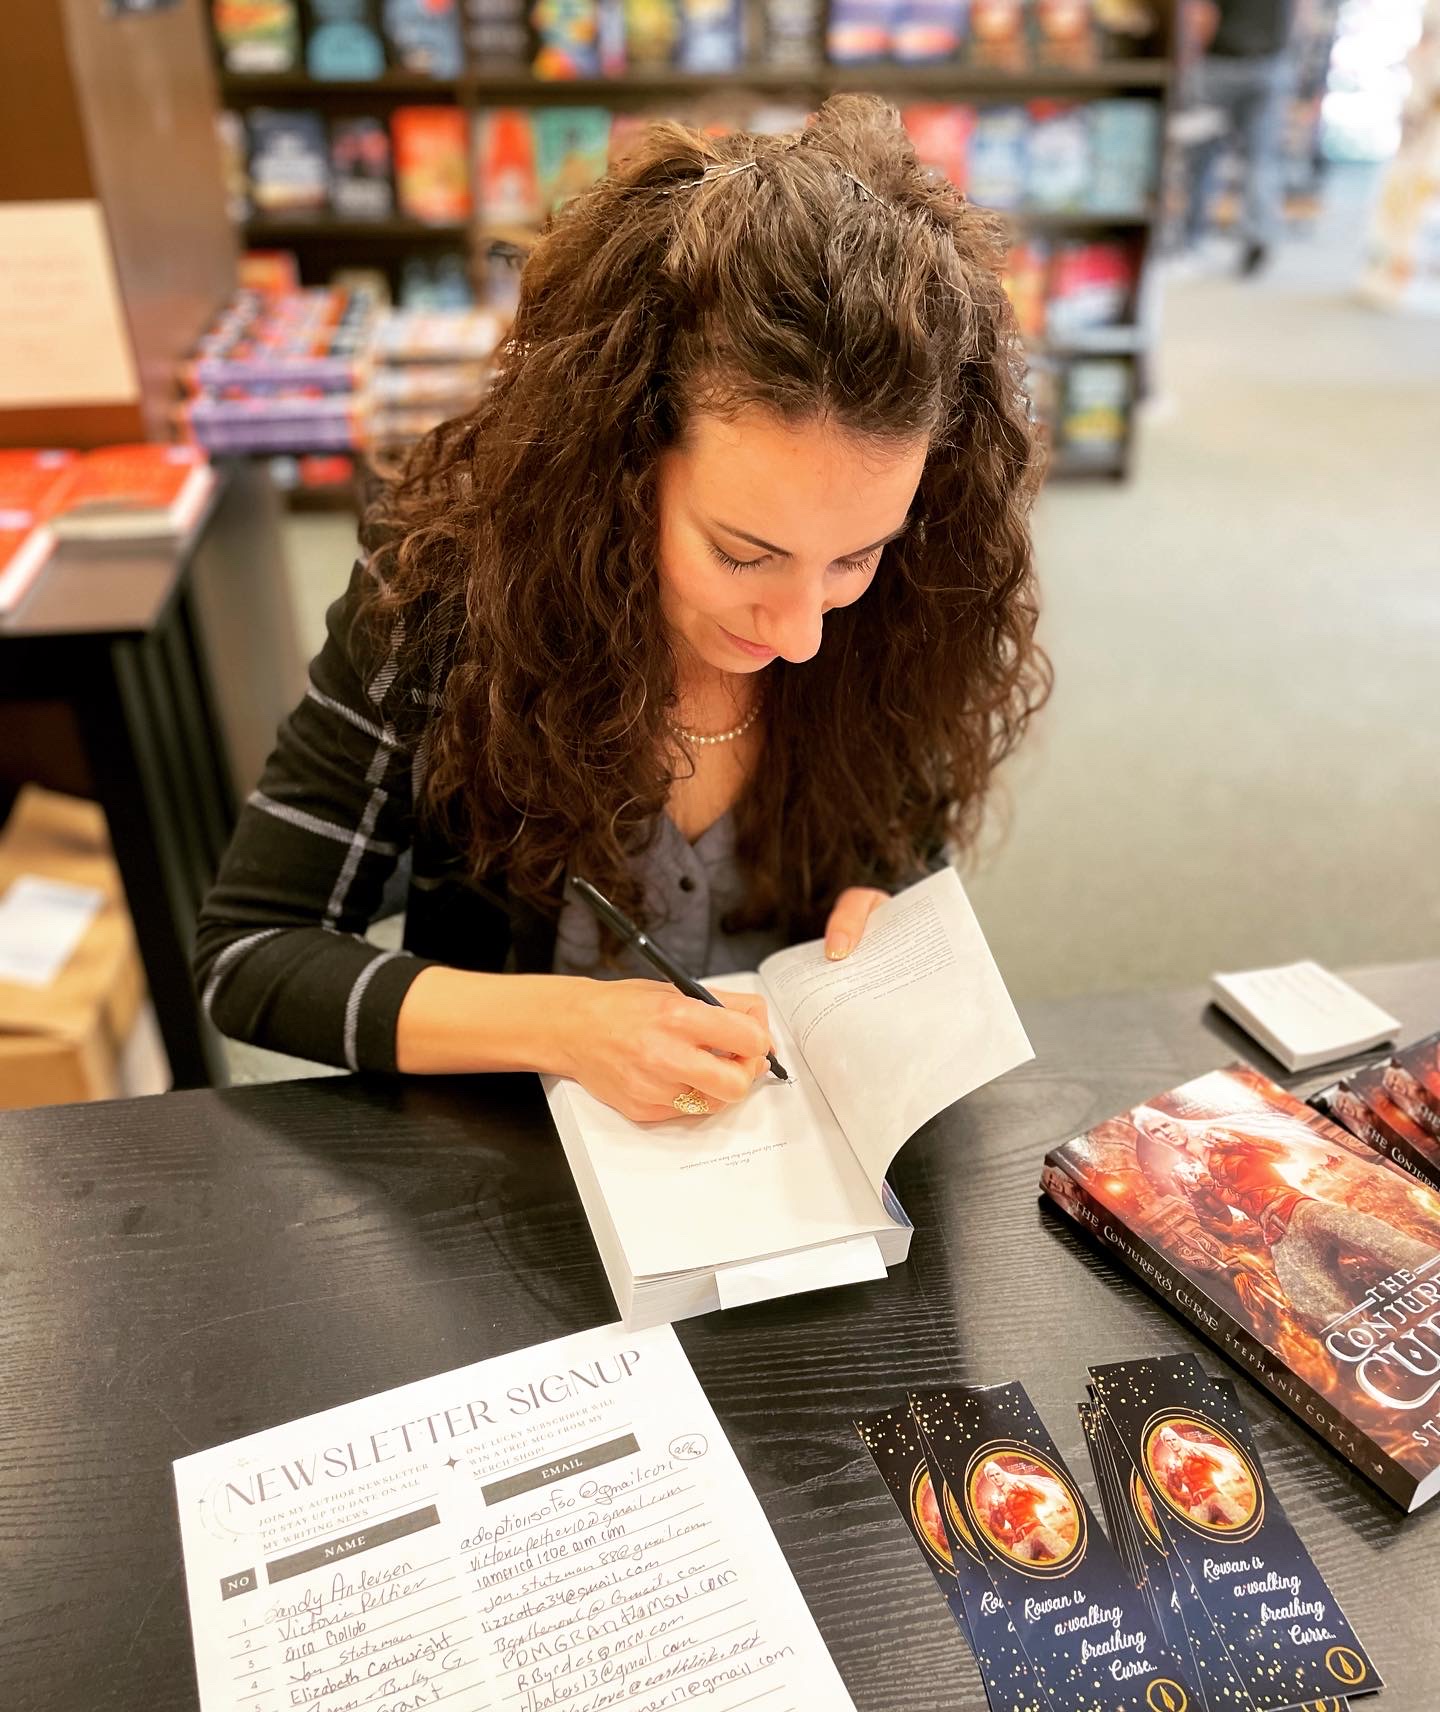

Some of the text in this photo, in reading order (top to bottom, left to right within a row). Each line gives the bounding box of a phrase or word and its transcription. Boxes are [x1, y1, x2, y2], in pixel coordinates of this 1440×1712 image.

[1365, 1124, 1389, 1149] THE
[1365, 1268, 1418, 1302] THE
[1075, 1201, 1099, 1228] THE
[1175, 1288, 1219, 1331] CURSE
[1224, 1333, 1302, 1403] STEPHANIE
[1305, 1404, 1358, 1452] COTTA
[226, 1350, 641, 1513] NEWSLETTER SIGNUP
[491, 1431, 523, 1447] LUCKY
[527, 1406, 589, 1433] SUBSCRIBER
[468, 1454, 490, 1467] WIN
[558, 1420, 586, 1435] FROM
[588, 1415, 604, 1425] MY
[473, 1460, 511, 1477] MERCH
[541, 1458, 584, 1479] EMAIL
[259, 1463, 429, 1527] JOIN MY AUTHOR NEWSLETTER
[261, 1479, 421, 1538] TO STAY UP TO DATE ON ALL
[263, 1509, 370, 1551] MY WRITING NEWS
[325, 1536, 366, 1558] NAME
[1203, 1556, 1265, 1581] Rowan is
[227, 1576, 250, 1591] NO
[1233, 1571, 1302, 1597] a walking
[1024, 1590, 1087, 1621] Rowan is
[1260, 1597, 1326, 1622] breathing
[242, 1618, 248, 1627] 1
[1054, 1604, 1123, 1636] a walking
[243, 1640, 252, 1649] 2
[1081, 1630, 1147, 1661] breathing
[248, 1659, 255, 1669] 3
[290, 1635, 453, 1704] Elizabeth Cartwright
[251, 1679, 258, 1689] 4
